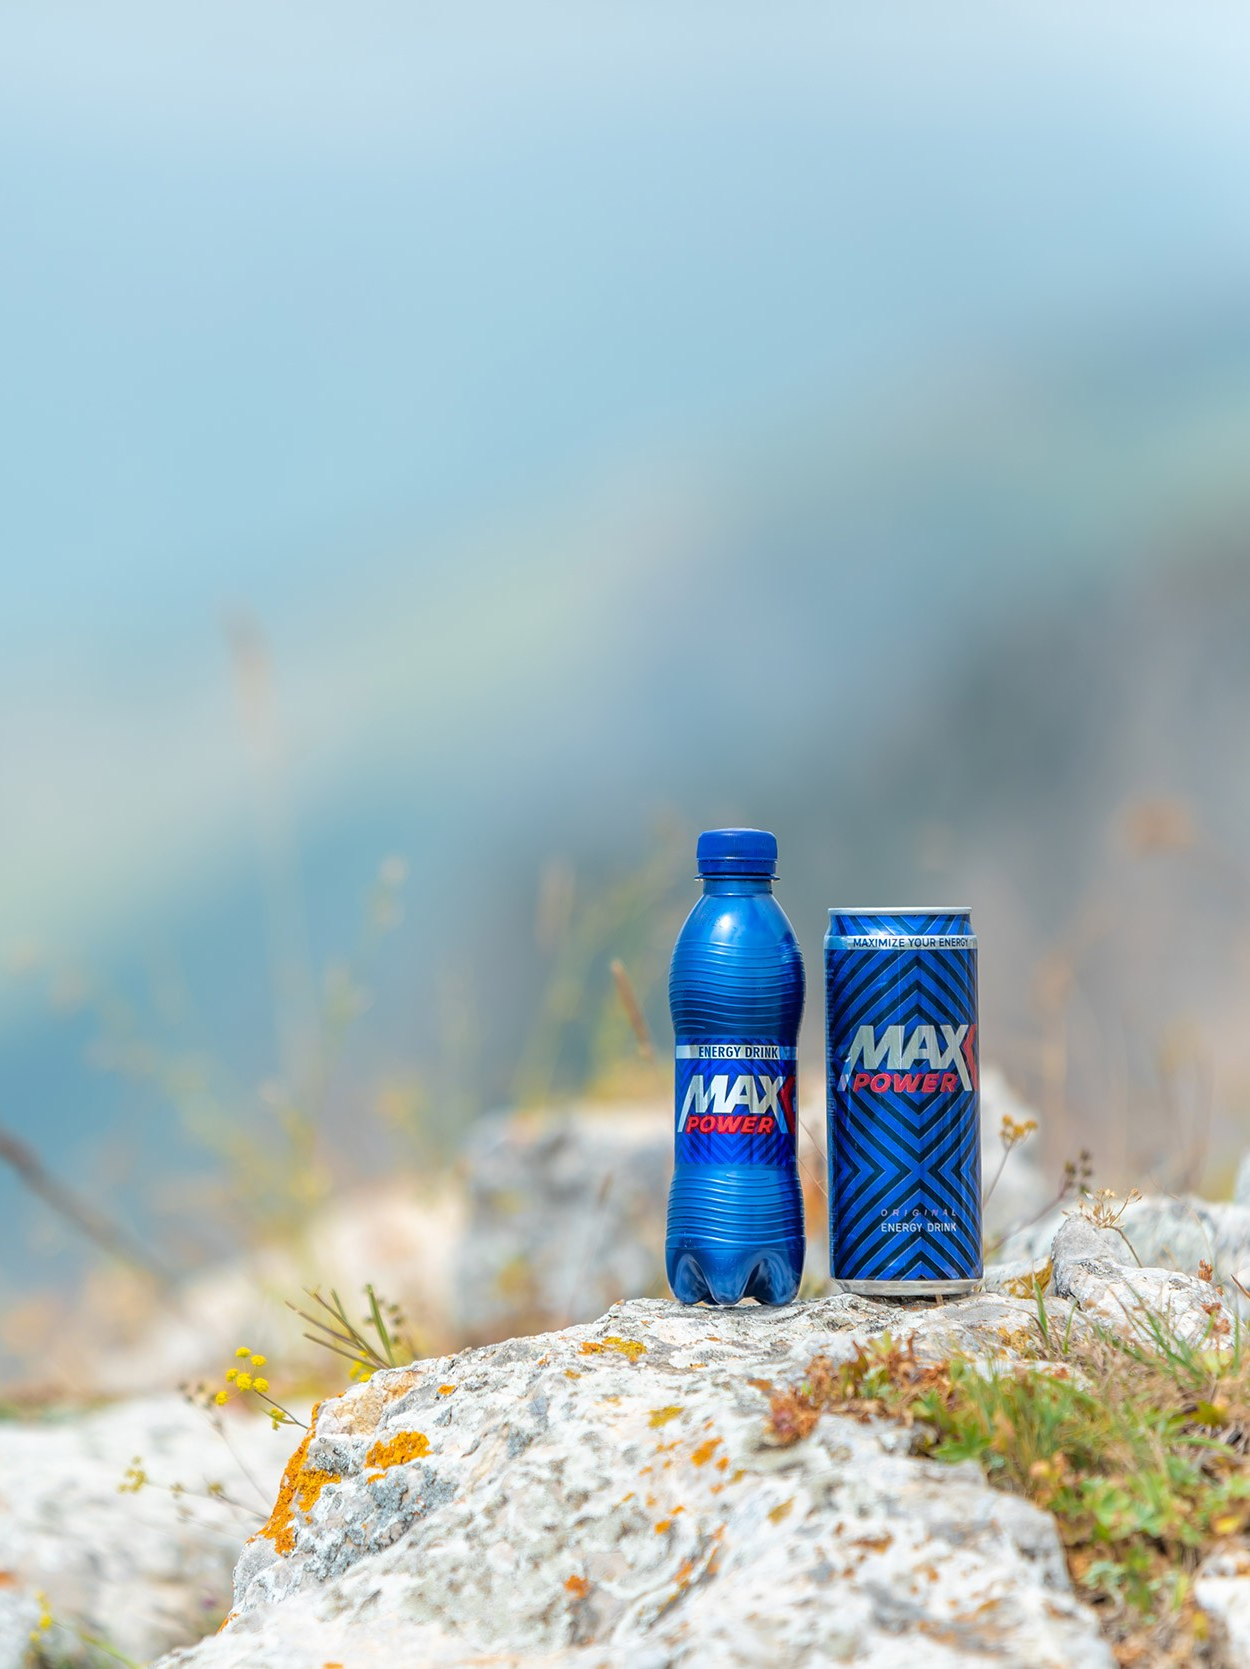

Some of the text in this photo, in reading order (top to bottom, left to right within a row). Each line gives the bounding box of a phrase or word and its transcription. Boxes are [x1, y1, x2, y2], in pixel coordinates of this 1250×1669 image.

[853, 937, 969, 947] MAXIMIZE YOUR ENERGY
[699, 1046, 778, 1059] ENERGY DRINK
[837, 1024, 973, 1092] MAX
[853, 1073, 959, 1093] POWER
[677, 1074, 789, 1133] MAX
[686, 1115, 775, 1134] POWER
[880, 1208, 957, 1217] ORIGINAL
[881, 1222, 957, 1233] ENERGY DRINK
